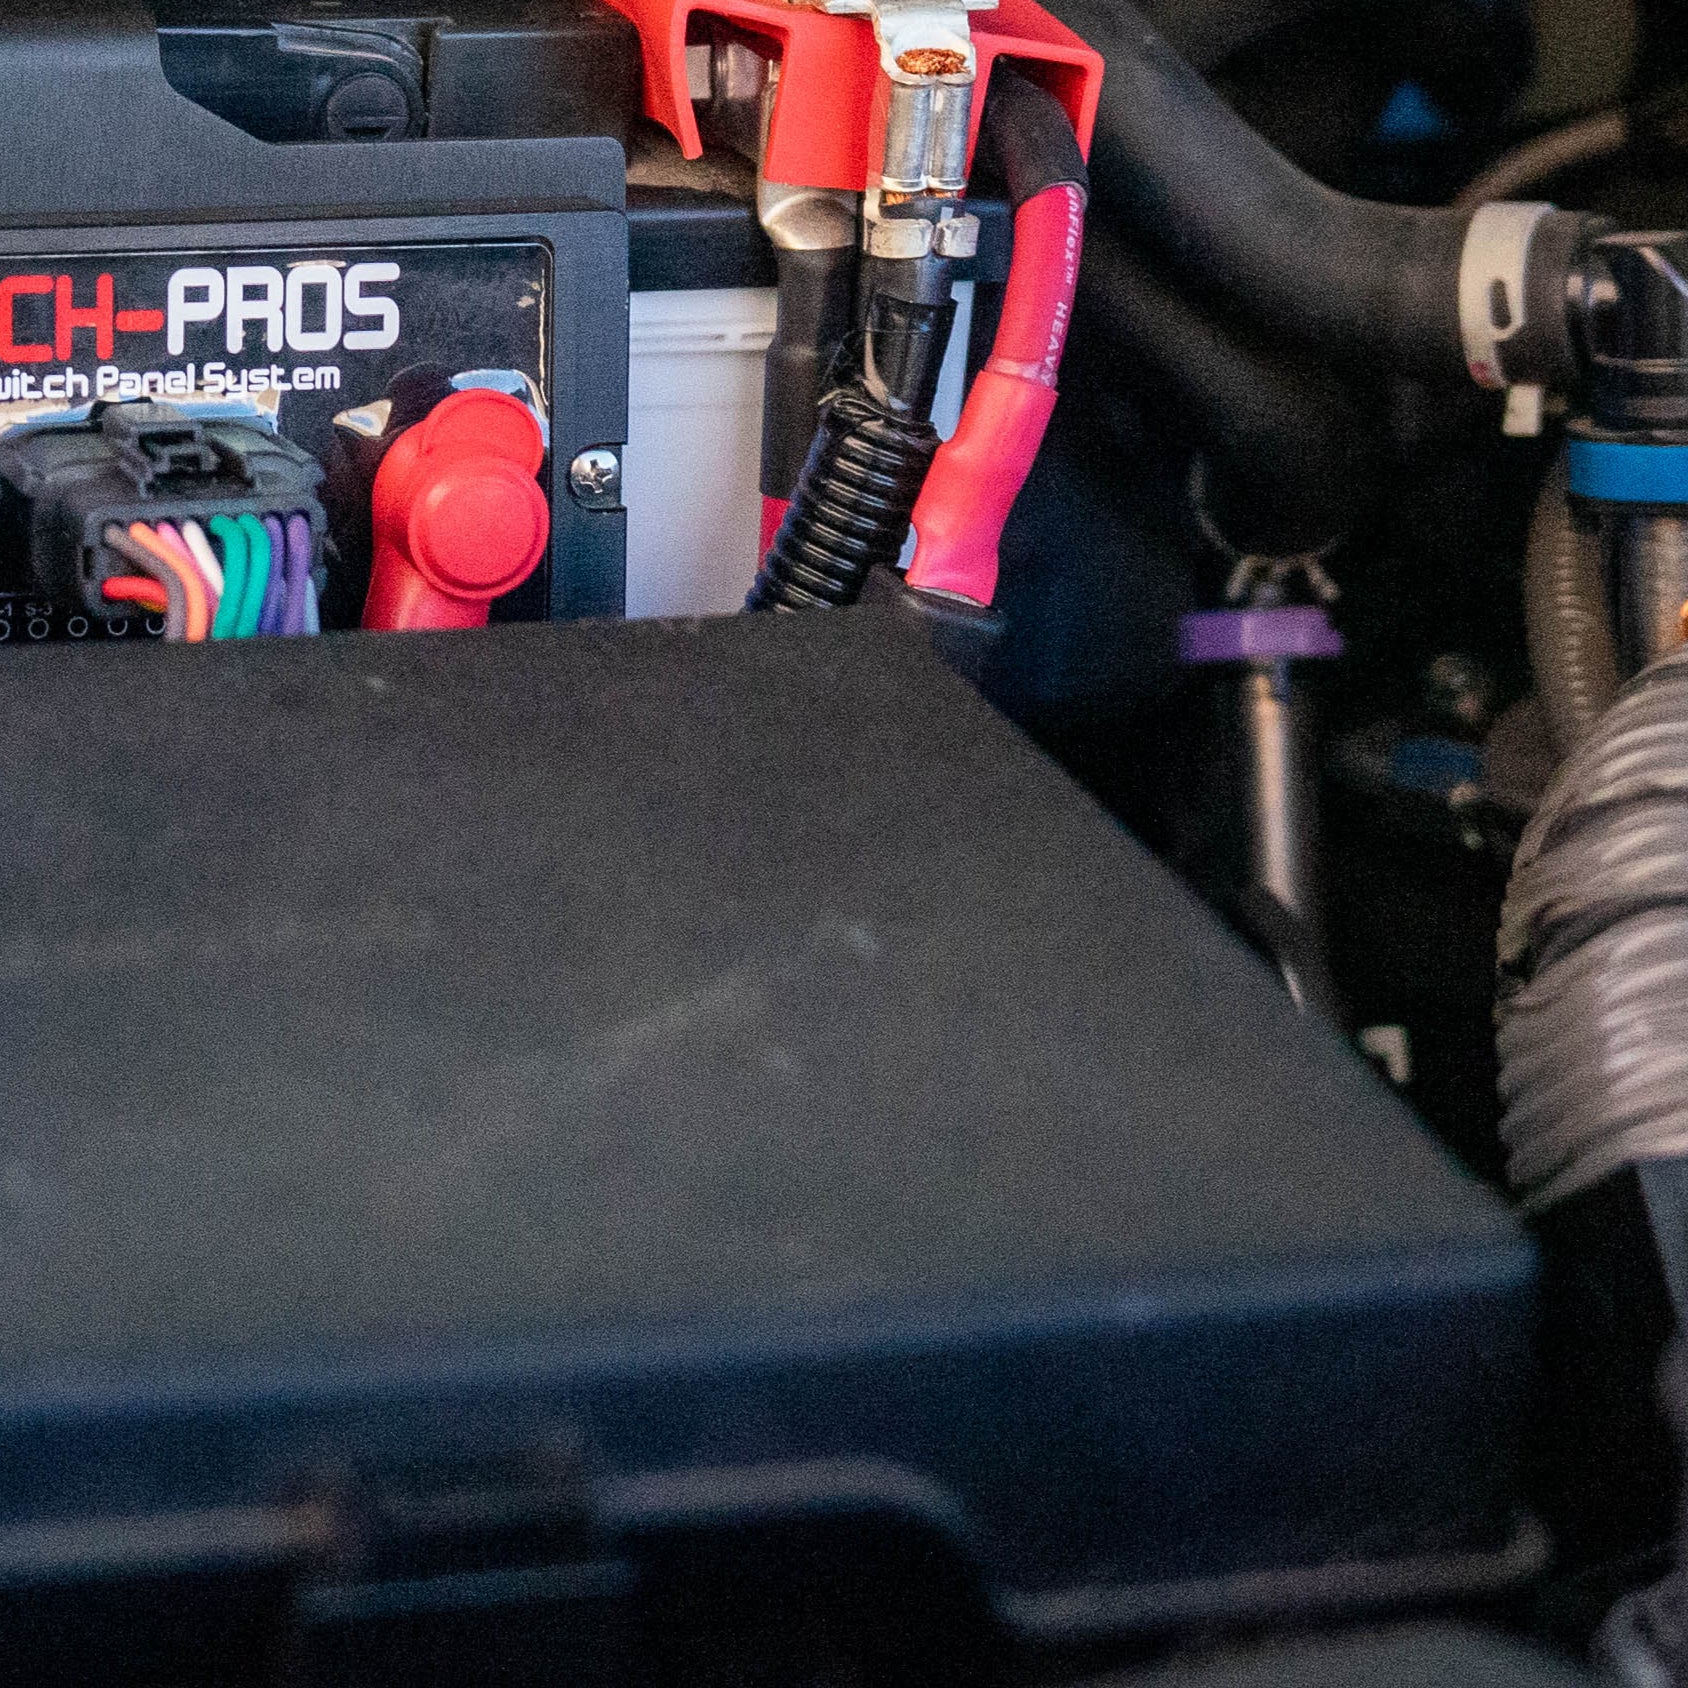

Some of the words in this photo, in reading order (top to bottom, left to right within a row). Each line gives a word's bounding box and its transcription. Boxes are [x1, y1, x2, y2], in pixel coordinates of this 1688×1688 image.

[1039, 301, 1068, 386] HEAVY
[96, 362, 196, 396] Panel
[202, 361, 341, 398] System
